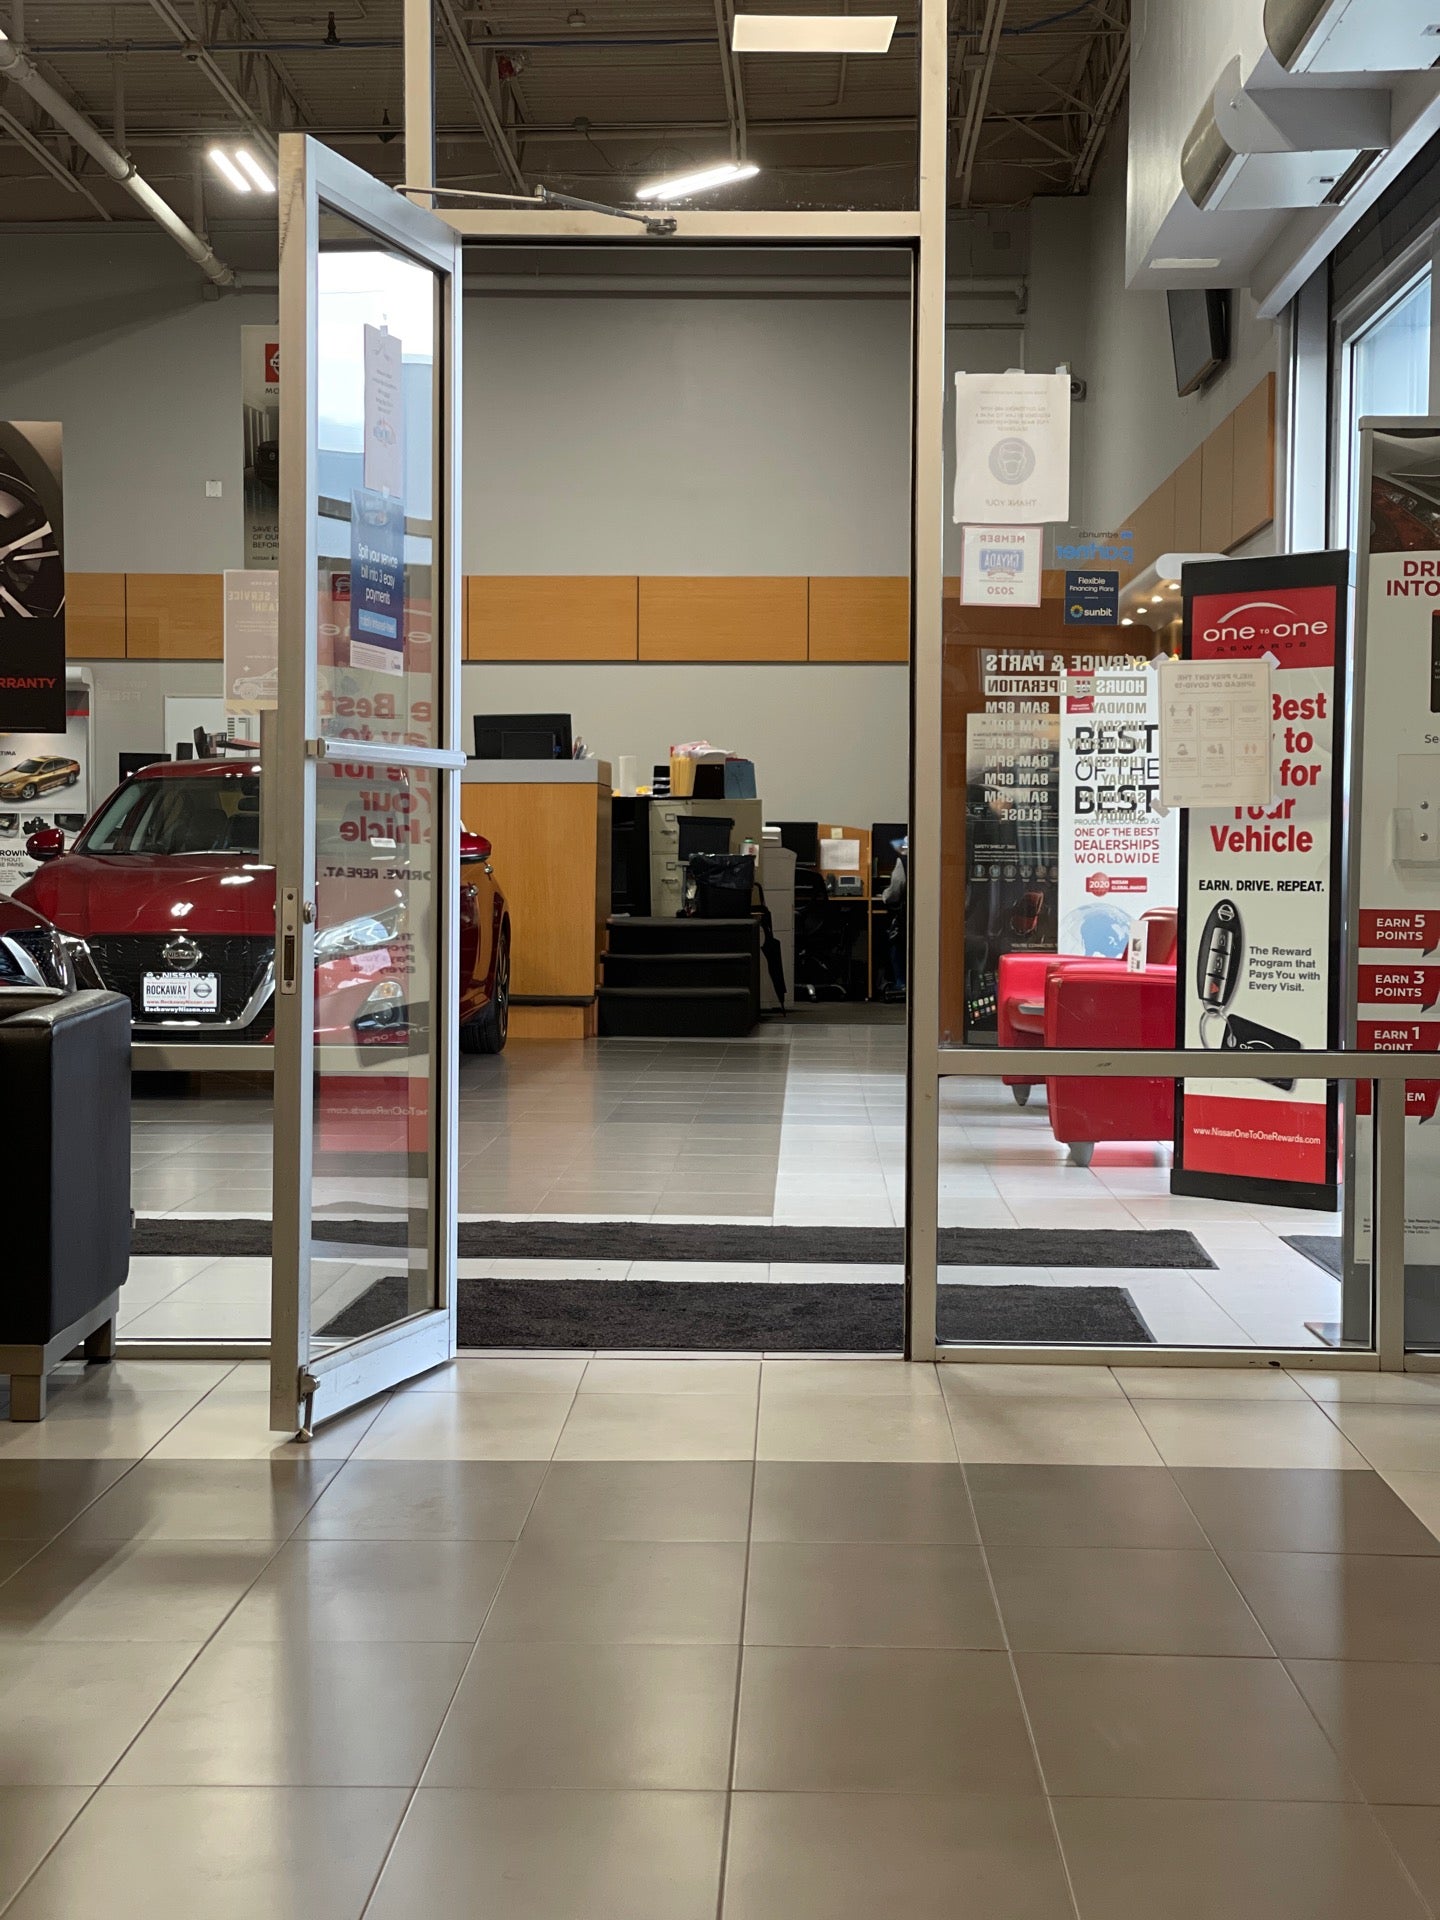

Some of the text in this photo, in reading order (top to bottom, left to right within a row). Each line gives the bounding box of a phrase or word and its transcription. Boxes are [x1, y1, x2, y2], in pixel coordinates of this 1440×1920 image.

[358, 543, 369, 561] Split
[361, 565, 369, 579] bill
[383, 574, 396, 590] easy
[1077, 576, 1106, 585] Flexible
[1386, 580, 1440, 597] INTO
[365, 587, 391, 605] payments
[1084, 605, 1113, 617] sunbit
[1203, 626, 1256, 642] one
[1273, 621, 1328, 638] one
[1075, 725, 1159, 755] BEST
[1284, 727, 1314, 753] to
[1075, 759, 1107, 781] OF
[1279, 759, 1322, 786] for
[1075, 785, 1160, 814] BEST
[1074, 827, 1160, 837] ONE OF THE BEST
[1074, 839, 1160, 850] DEALERSHIPS
[1210, 825, 1314, 853] Vehicle
[1074, 852, 1160, 864] WORLDWIDE
[1089, 881, 1111, 889] 2020
[1199, 880, 1325, 892] EARN. DRIVE. REPEAT.
[1376, 914, 1425, 928] EARN 5
[1376, 931, 1424, 941] POINTS
[1249, 946, 1312, 956] The Reward
[1249, 958, 1316, 969] Program that
[1249, 970, 1321, 981] Pays You with
[1375, 971, 1425, 985] EARN 3
[146, 985, 187, 995] ROCKAWAY
[1248, 982, 1305, 992] Every Visit.
[1375, 988, 1423, 997] POINTS
[1374, 1026, 1420, 1040] EARN 1
[1374, 1042, 1414, 1051] POINT
[1193, 1127, 1321, 1145] www.NissanOneToOneRewards.com
